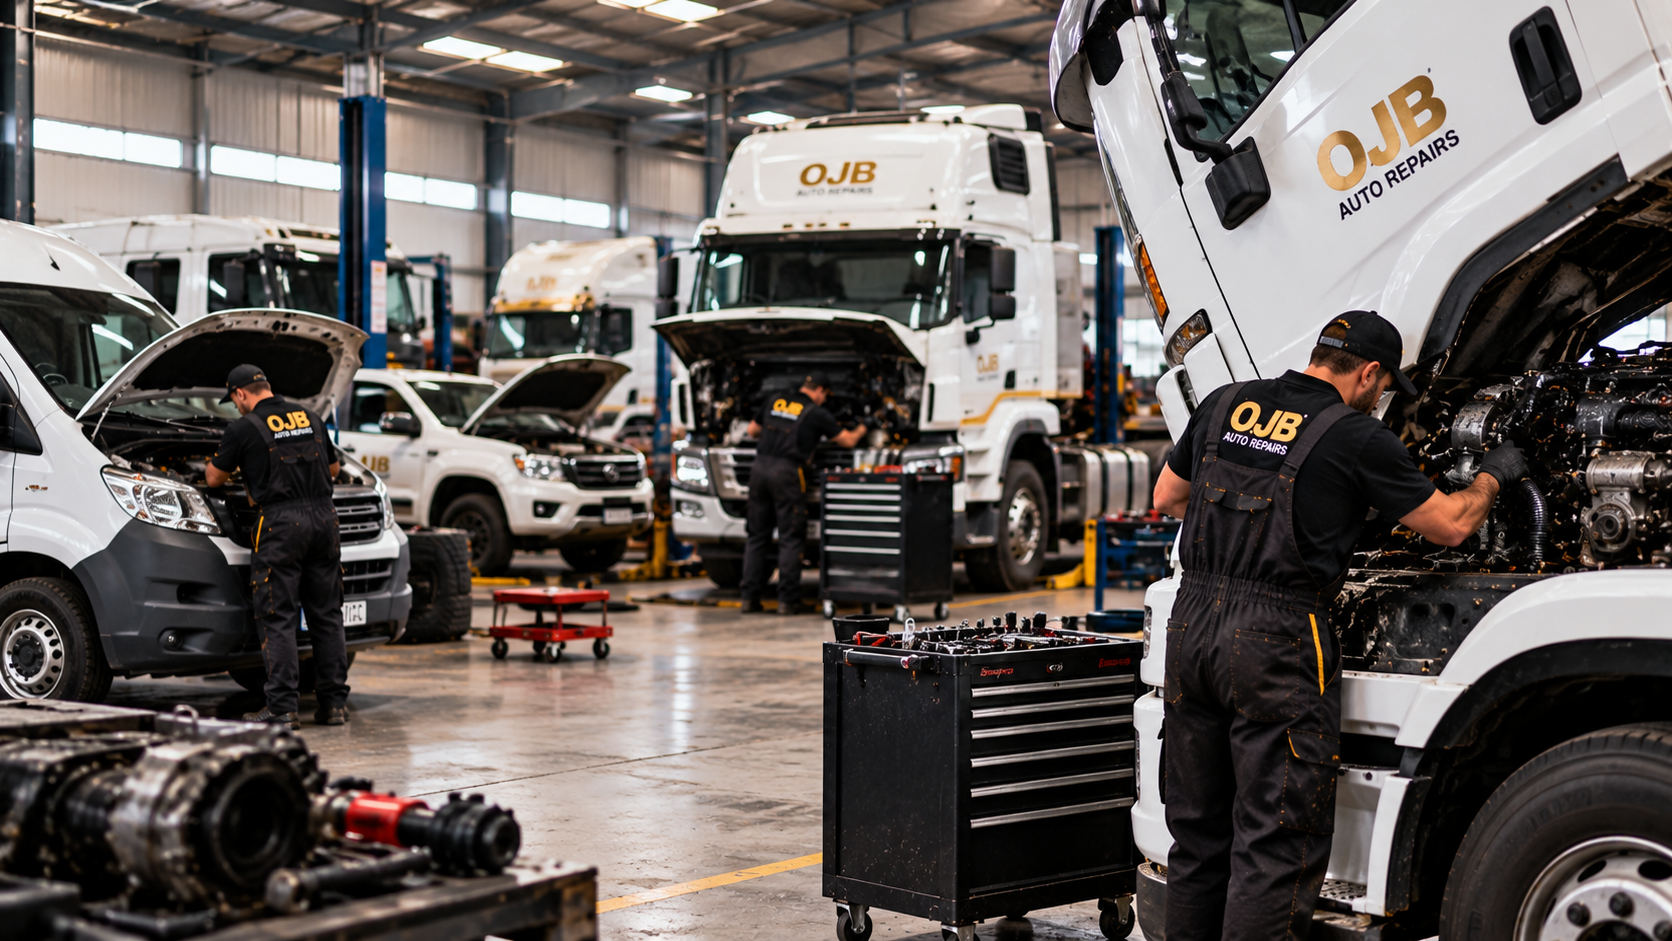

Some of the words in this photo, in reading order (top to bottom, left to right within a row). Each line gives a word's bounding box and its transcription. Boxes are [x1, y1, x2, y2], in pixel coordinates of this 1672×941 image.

[1317, 75, 1447, 191] OJB
[800, 161, 877, 186] OJB
[1339, 180, 1384, 220] AUTO
[1384, 129, 1460, 188] REPAIRS
[267, 411, 310, 432] OJB
[1230, 401, 1303, 442] OJB
[1222, 431, 1249, 446] AUTO
[1249, 438, 1288, 455] REPAIRS
